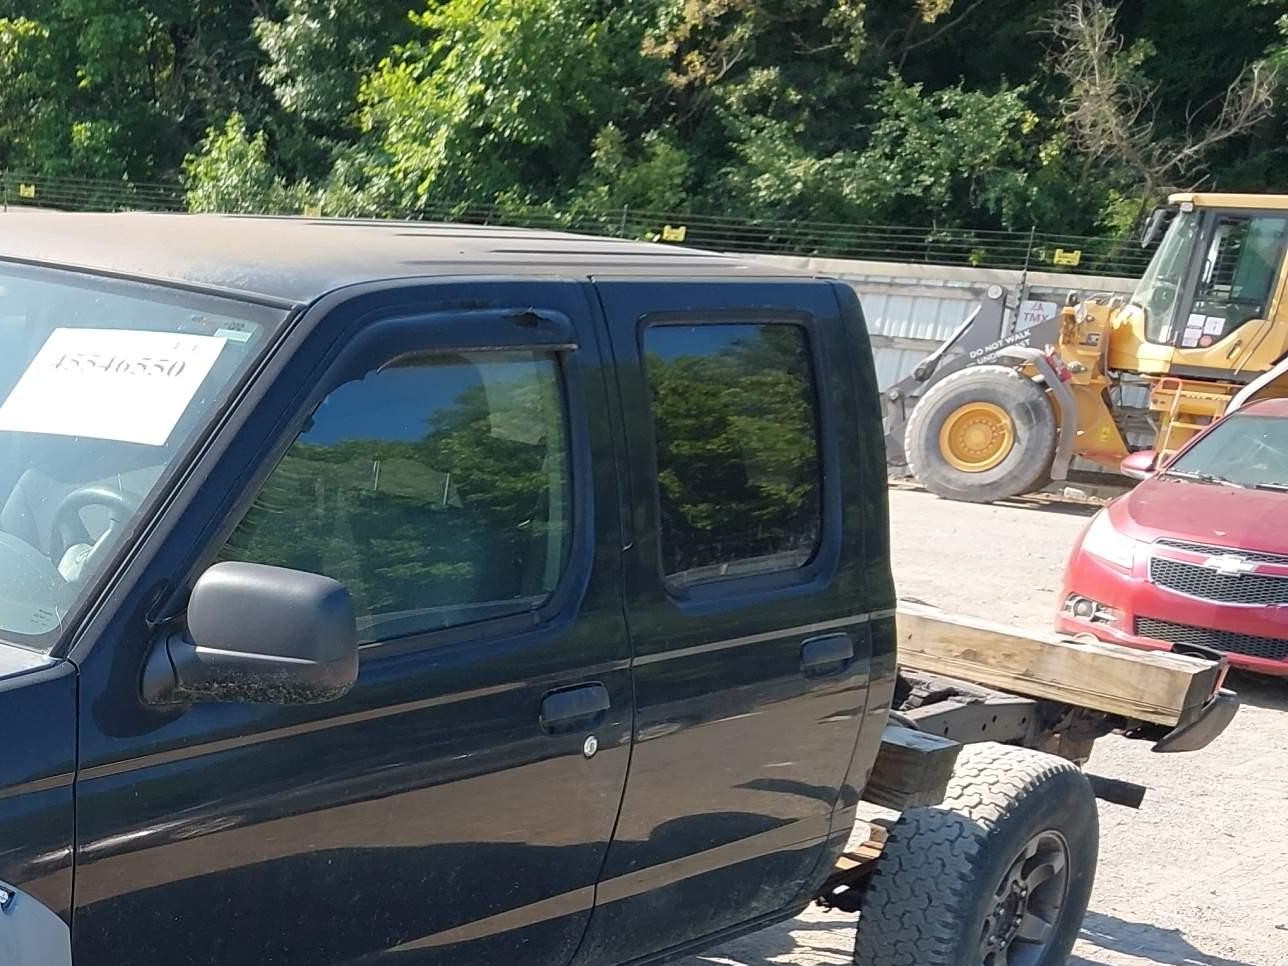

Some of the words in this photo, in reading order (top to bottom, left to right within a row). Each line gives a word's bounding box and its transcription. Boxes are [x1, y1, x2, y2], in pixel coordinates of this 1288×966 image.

[969, 348, 984, 359] DO
[984, 340, 1003, 352] NOT
[1005, 329, 1031, 344] WALK
[977, 350, 1001, 364] UND
